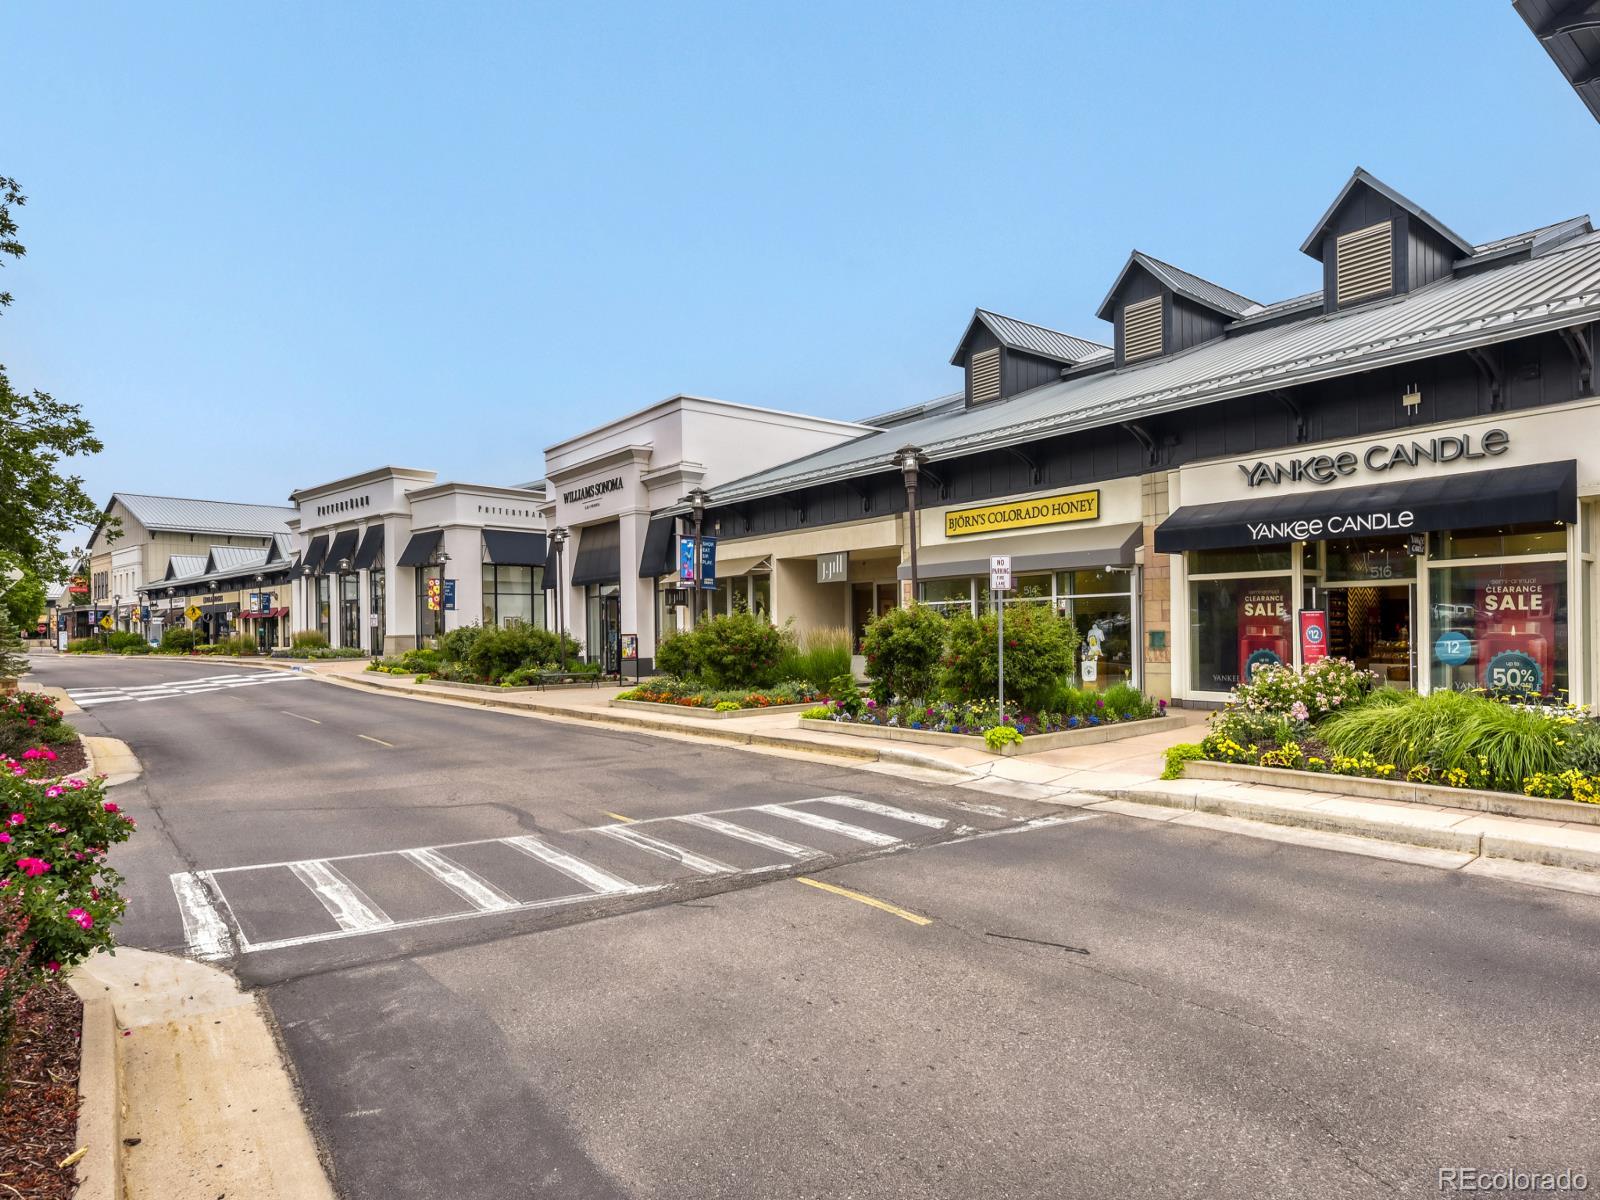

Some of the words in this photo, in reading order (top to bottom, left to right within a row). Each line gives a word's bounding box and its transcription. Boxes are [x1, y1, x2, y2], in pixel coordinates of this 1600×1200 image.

[563, 484, 595, 504] WILLIAMS
[595, 476, 624, 496] SONOMA
[948, 513, 985, 531] BJÖRN'S
[987, 505, 1049, 524] COLORADO
[1051, 498, 1095, 515] HONEY
[1370, 566, 1391, 578] 516
[1485, 585, 1542, 593] CLEARANCE
[1244, 603, 1285, 616] SALE
[1485, 594, 1542, 610] SALE
[1493, 668, 1535, 687] 50%
